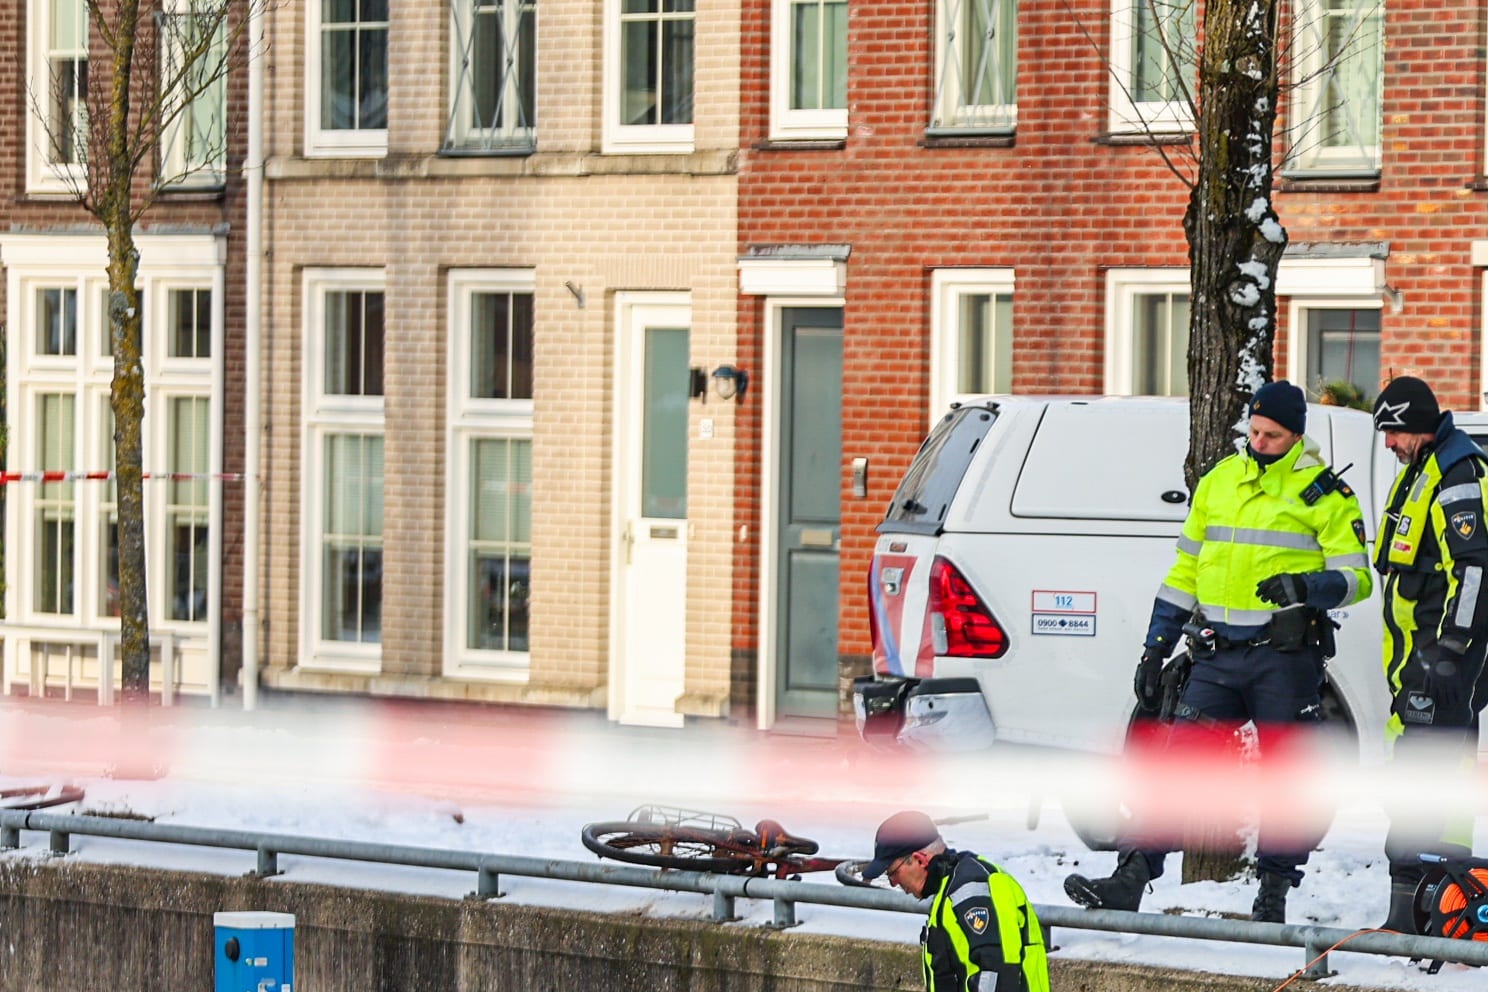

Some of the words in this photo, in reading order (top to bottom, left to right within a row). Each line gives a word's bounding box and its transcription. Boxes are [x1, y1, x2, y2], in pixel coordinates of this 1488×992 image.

[1055, 595, 1073, 606] 112
[1037, 619, 1058, 627] 0900
[1068, 620, 1089, 628] 8844
